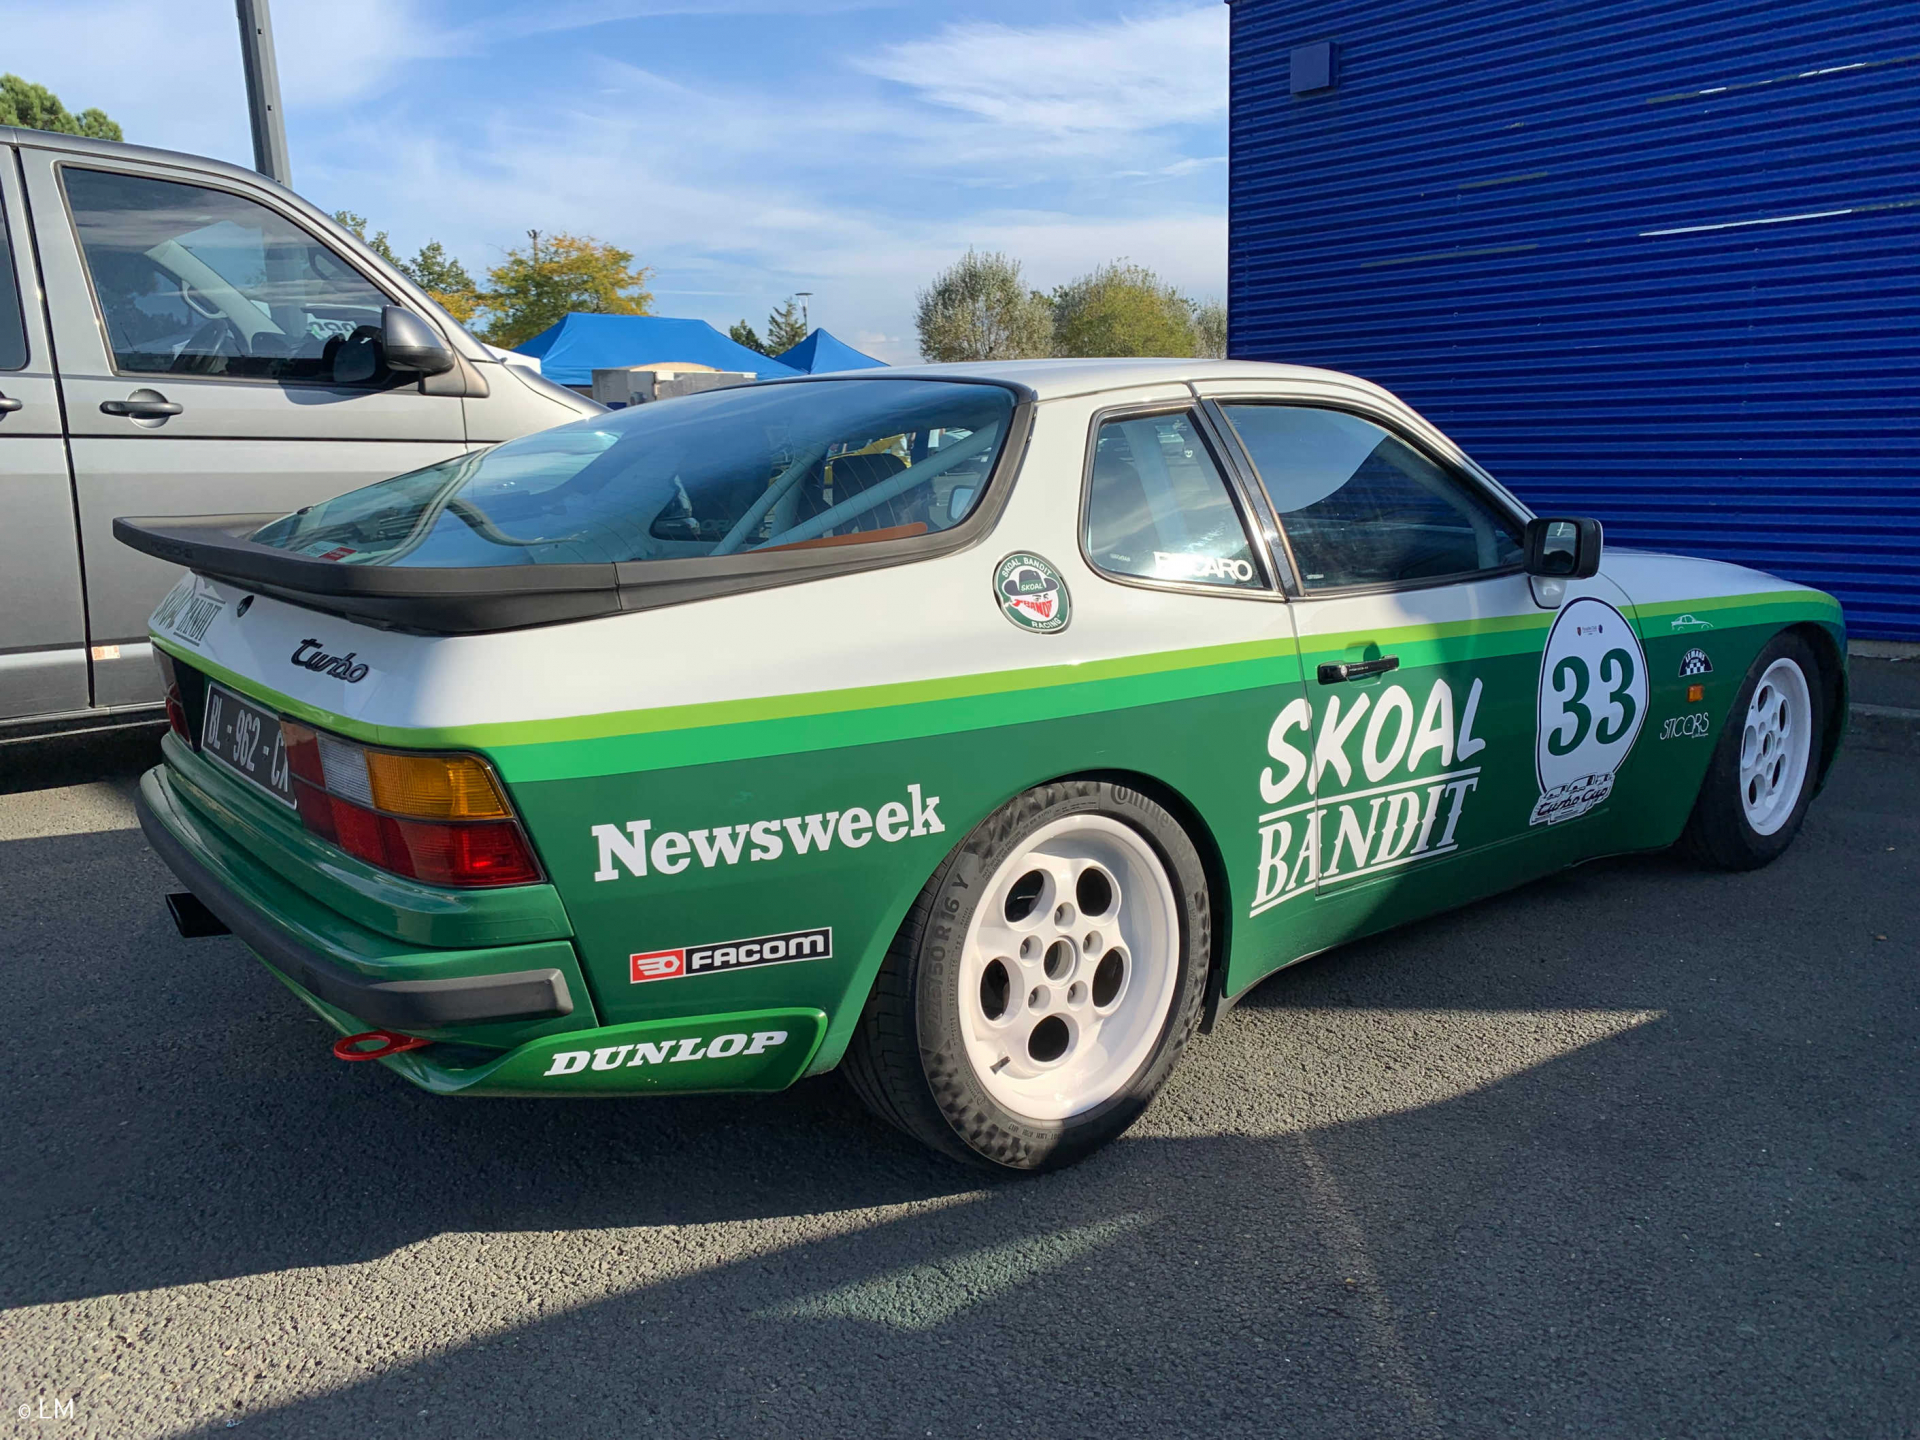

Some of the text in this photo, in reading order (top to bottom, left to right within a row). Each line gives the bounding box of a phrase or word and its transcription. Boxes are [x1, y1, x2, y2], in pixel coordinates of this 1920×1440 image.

[1001, 557, 1053, 577] SKOAL BANDIT
[1153, 551, 1253, 582] RARO
[1020, 583, 1043, 591] SKOAL
[1031, 617, 1062, 629] RACING
[1547, 648, 1637, 757] 33
[1259, 678, 1486, 804] SKOAL
[591, 783, 946, 882] Newsweek
[1251, 777, 1479, 908] BANDIT
[691, 934, 825, 969] FACOM
[543, 1030, 788, 1076] DUNLOP
